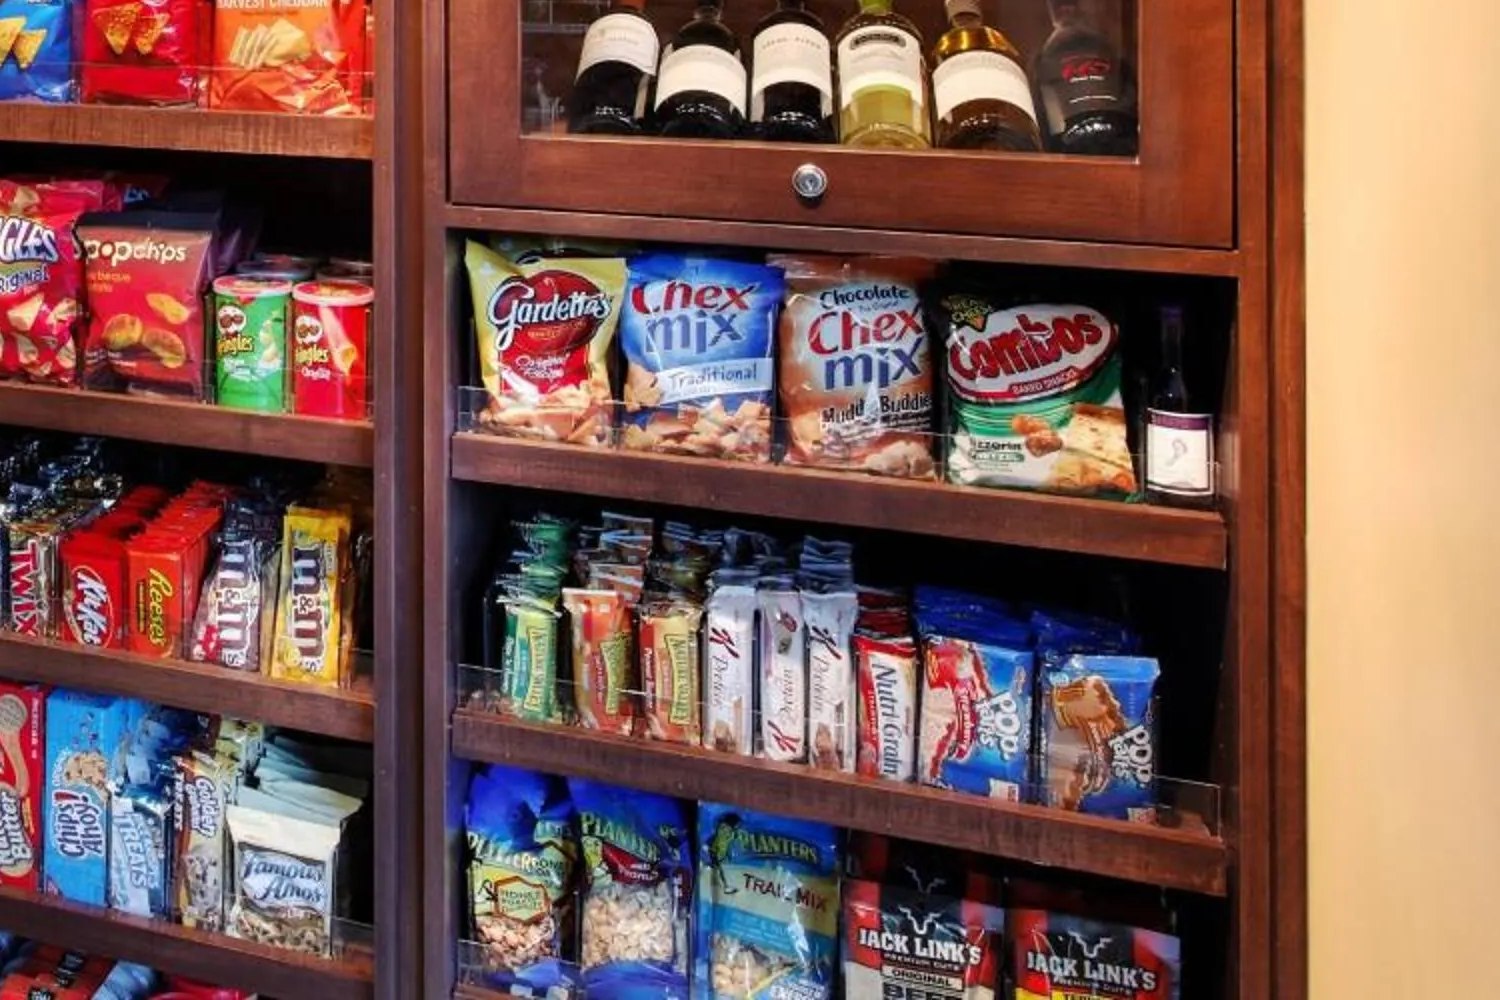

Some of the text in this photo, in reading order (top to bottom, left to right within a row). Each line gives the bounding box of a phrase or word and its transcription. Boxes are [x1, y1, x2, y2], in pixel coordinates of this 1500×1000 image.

[487, 280, 614, 350] Gardetto's
[819, 284, 910, 310] Chocolate
[644, 311, 743, 355] mix
[808, 303, 925, 356] Chex
[950, 313, 1104, 381] Combos
[668, 363, 758, 391] Traditional
[825, 337, 924, 390] mix
[821, 398, 866, 424] Mudd
[147, 567, 175, 646] Reese's
[0, 790, 33, 862] Butter
[55, 802, 83, 858] Chips
[193, 776, 220, 838] Golden
[114, 813, 148, 888] TREATS
[243, 850, 324, 882] Famous
[254, 876, 326, 903] Amos
[913, 937, 982, 965] LINK'S
[1083, 959, 1157, 991] LINK'S
